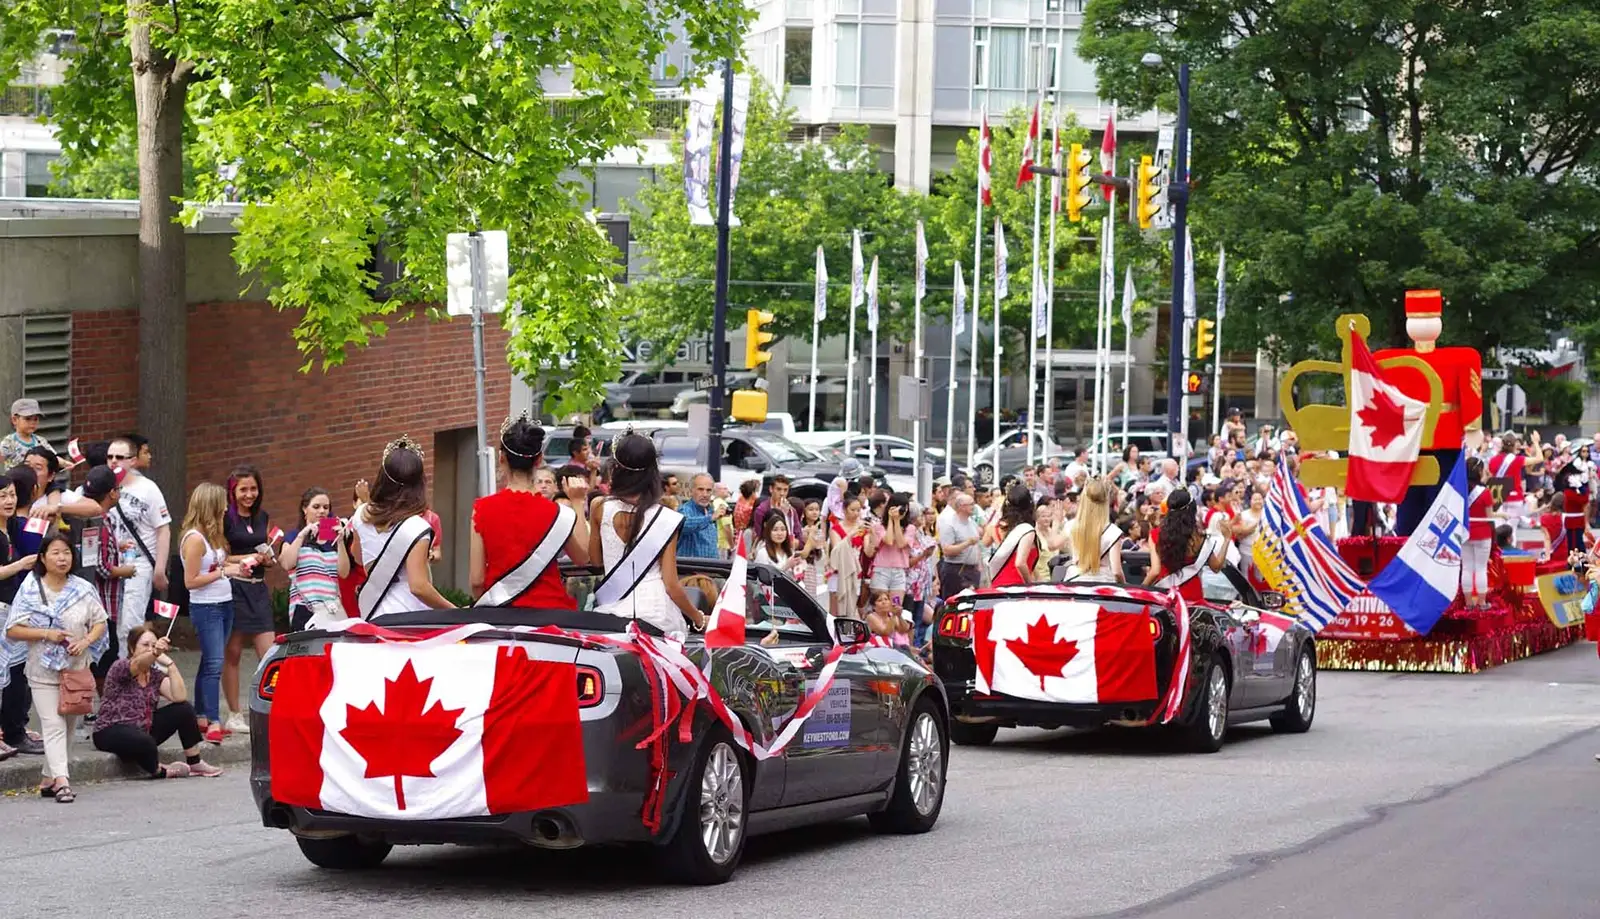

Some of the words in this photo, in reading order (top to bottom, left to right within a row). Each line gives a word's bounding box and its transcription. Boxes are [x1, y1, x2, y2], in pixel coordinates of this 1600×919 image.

[1355, 615, 1368, 626] 19
[1378, 616, 1394, 627] 26
[803, 731, 850, 743] KEYWESTFORD.COM
